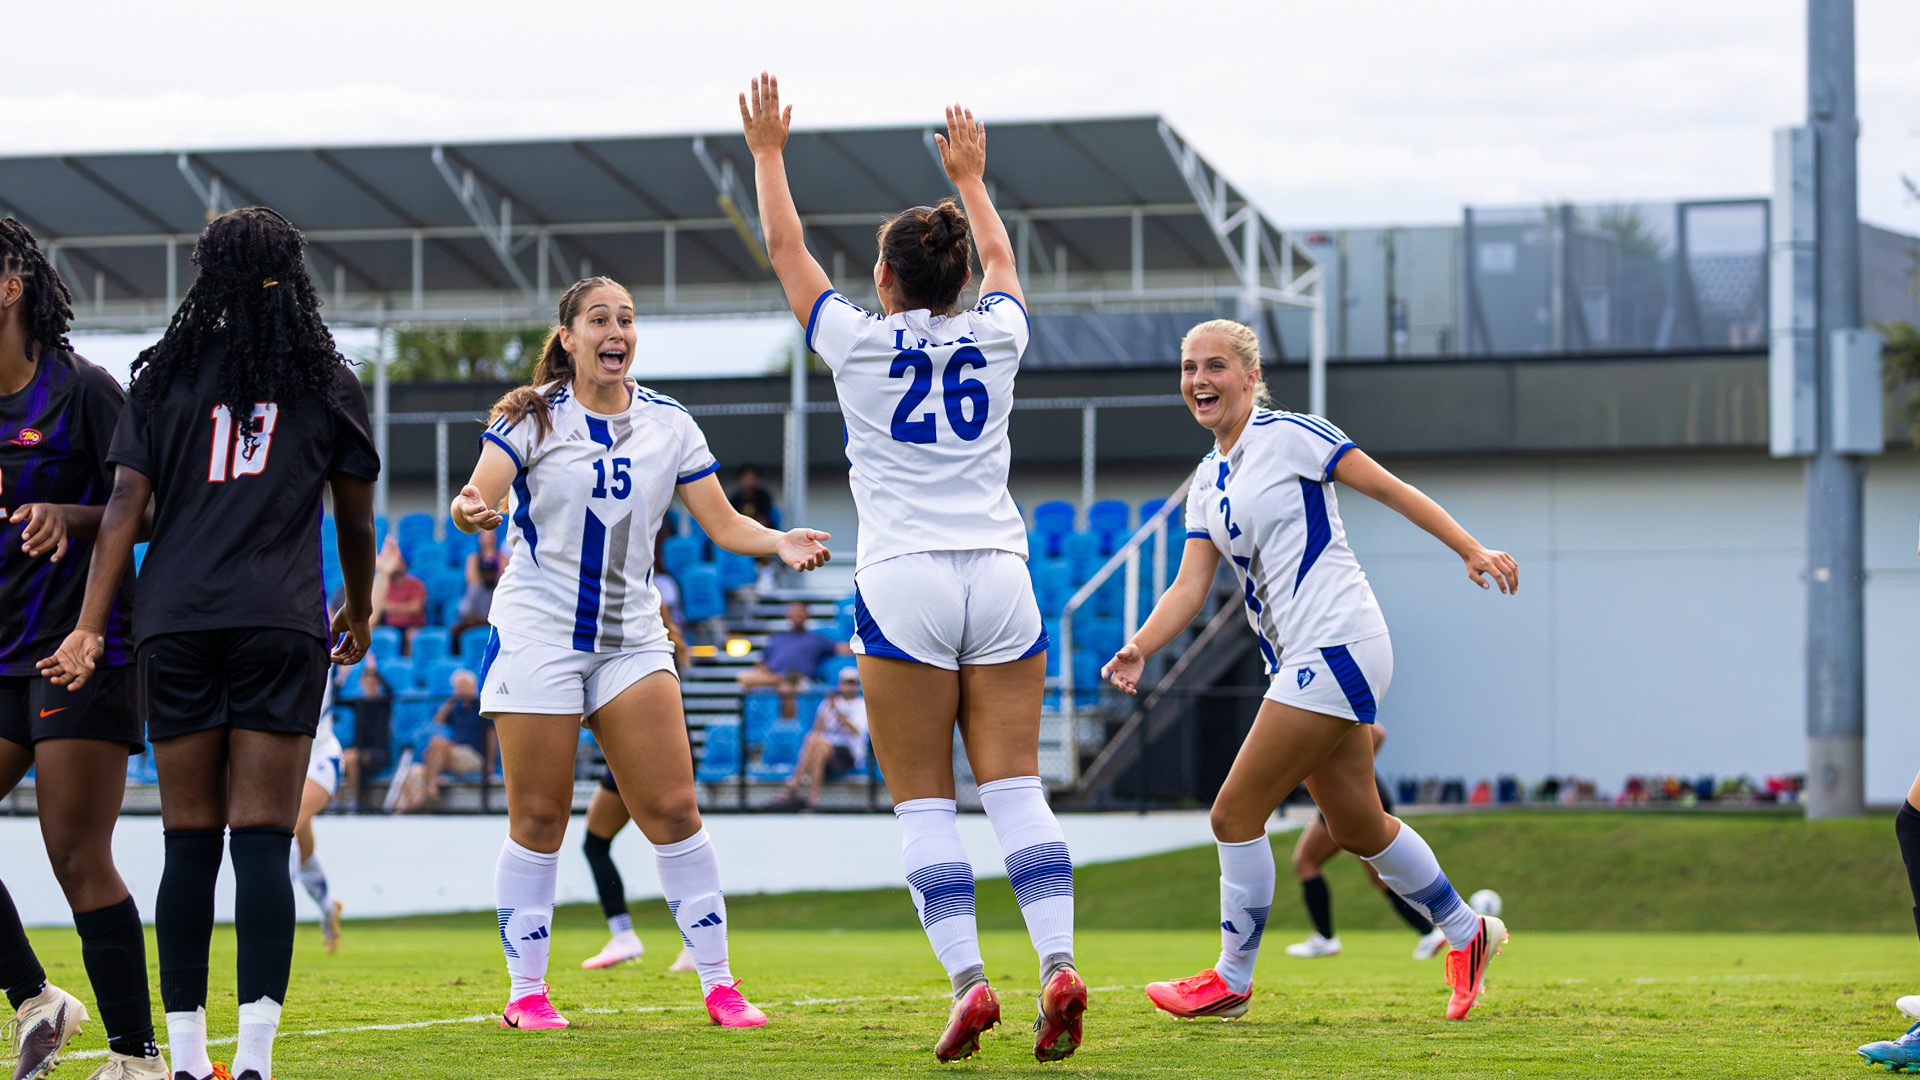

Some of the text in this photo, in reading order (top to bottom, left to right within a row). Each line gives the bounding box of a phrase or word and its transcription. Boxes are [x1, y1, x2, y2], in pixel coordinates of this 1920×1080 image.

[889, 346, 989, 444] 26
[207, 401, 279, 483] 18
[591, 457, 632, 500] 15
[1220, 496, 1242, 541] 2
